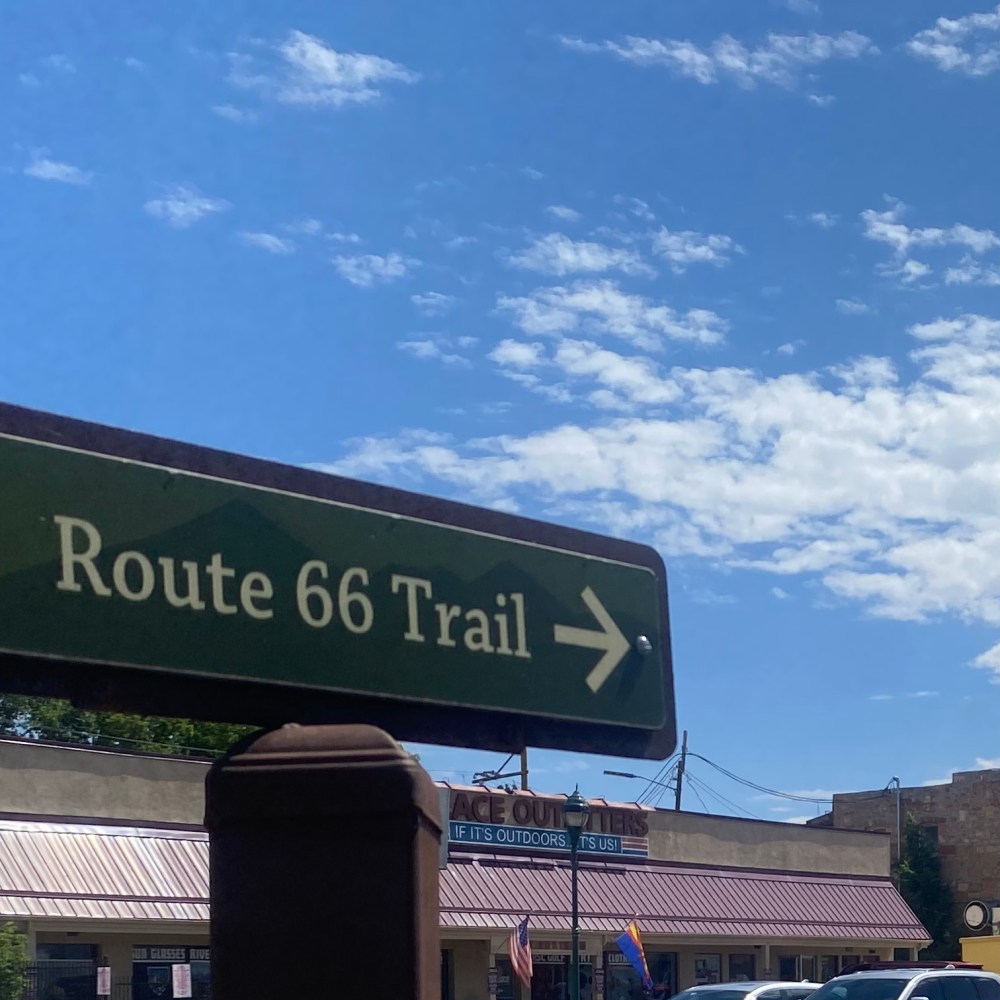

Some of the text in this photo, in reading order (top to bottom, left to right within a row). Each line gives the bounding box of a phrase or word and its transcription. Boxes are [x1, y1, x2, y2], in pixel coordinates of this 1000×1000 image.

[54, 514, 532, 658] Route 66 Trail
[513, 798, 650, 838] OUTTTERS
[455, 825, 467, 838] IF
[470, 826, 493, 841] IT'S
[577, 836, 596, 850] T'S
[599, 837, 618, 851] US!
[150, 948, 186, 959] GLASSES
